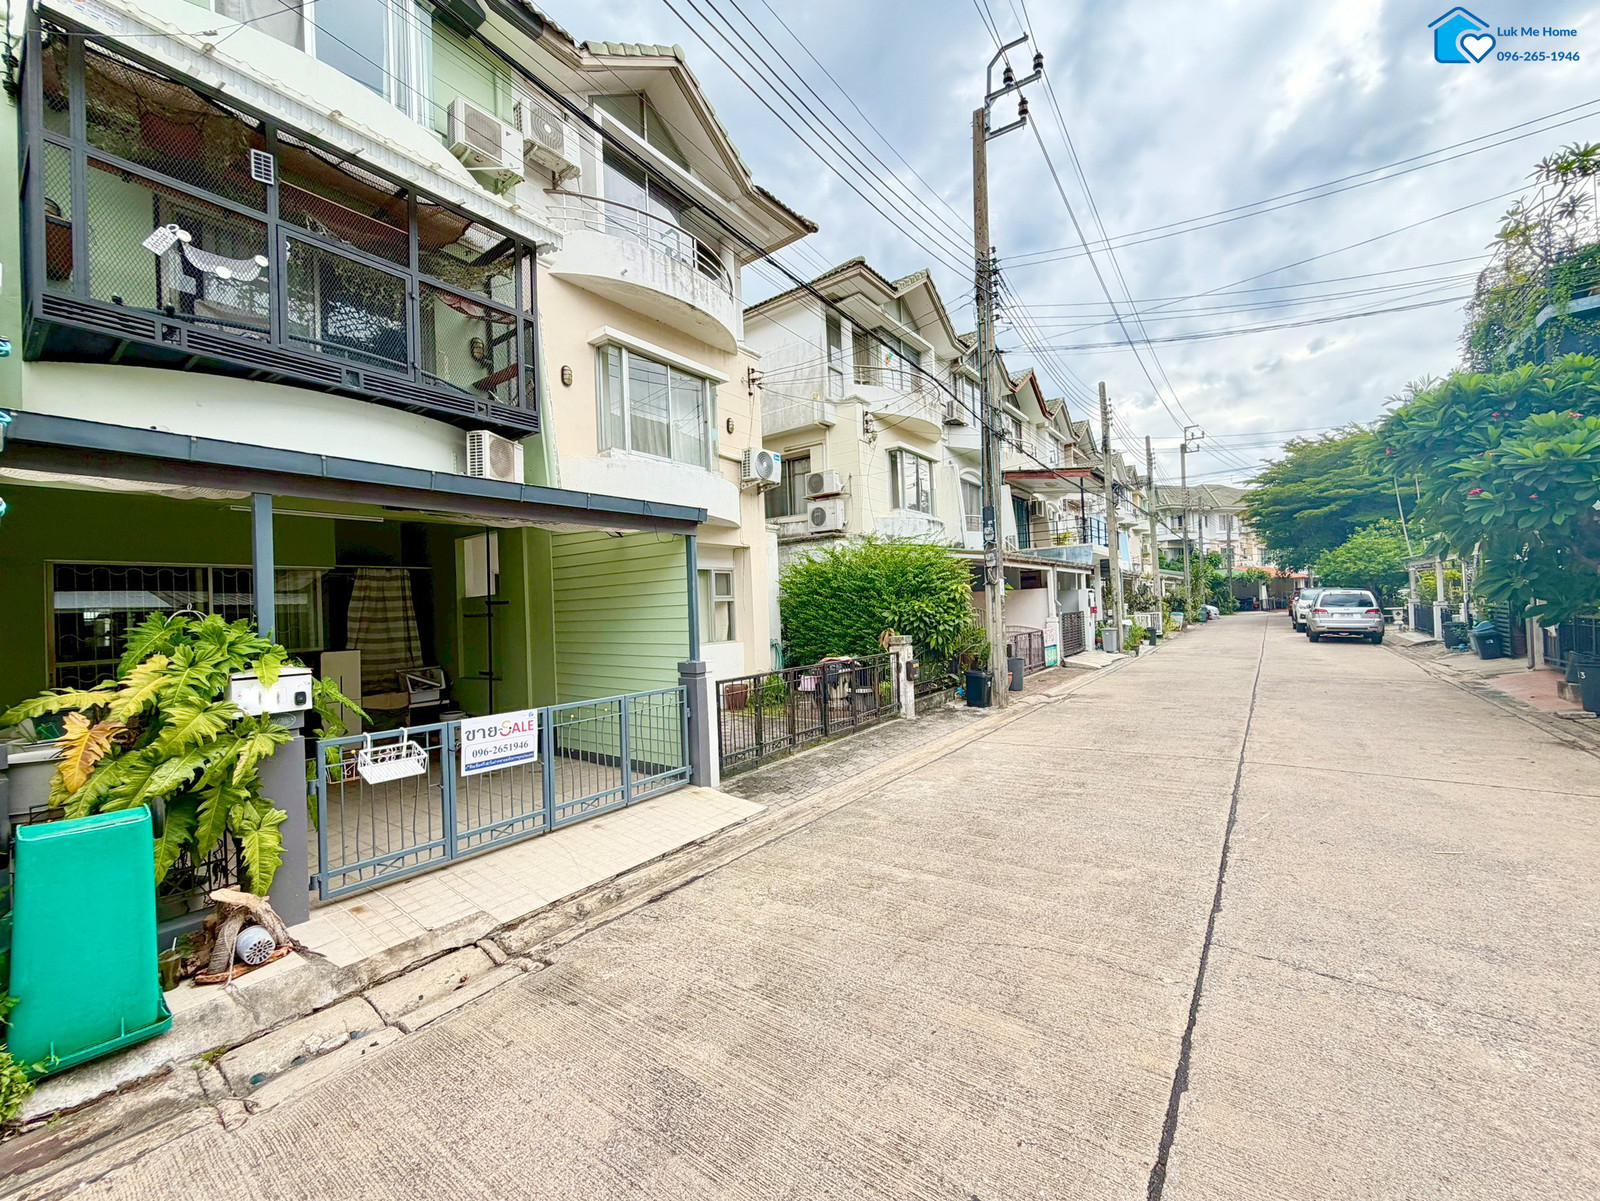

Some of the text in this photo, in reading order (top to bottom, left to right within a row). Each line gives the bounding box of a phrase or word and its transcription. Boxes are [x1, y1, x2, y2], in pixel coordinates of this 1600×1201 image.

[465, 720, 534, 741] ขาย SALE
[472, 740, 529, 758] 096-2651946
